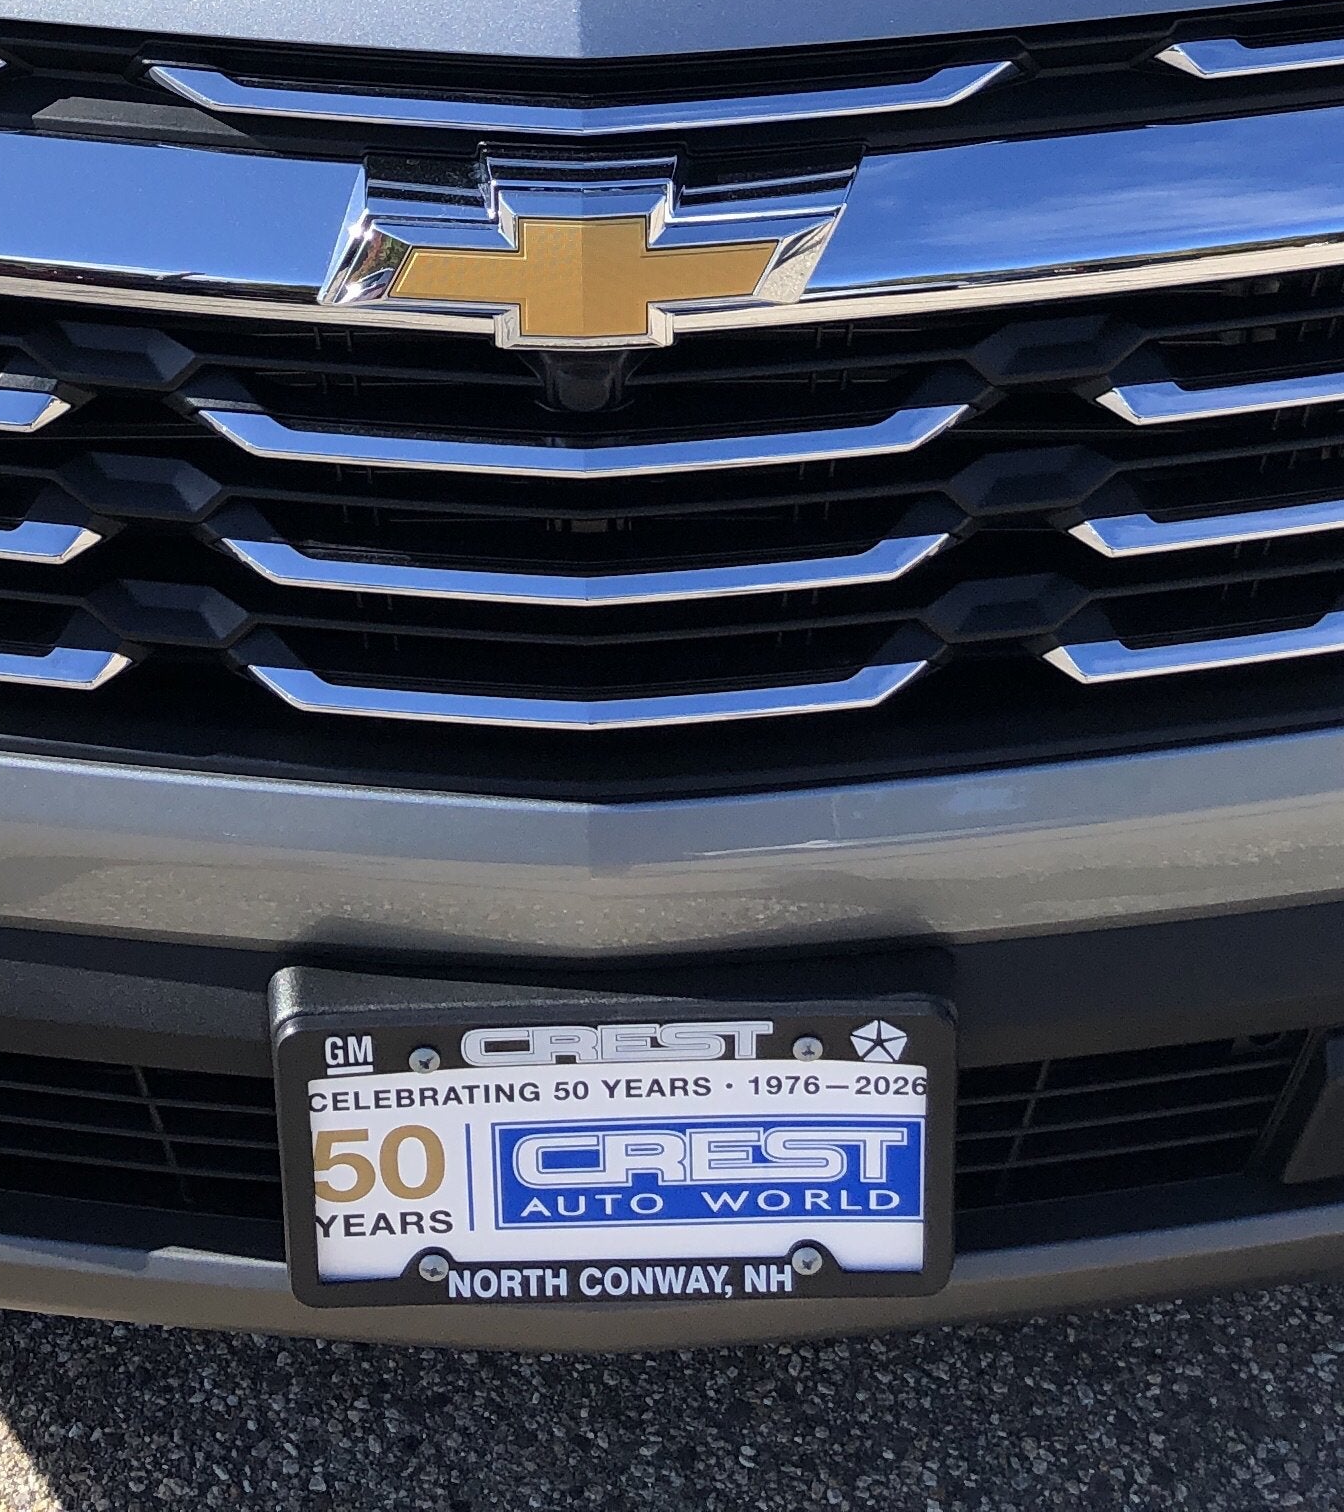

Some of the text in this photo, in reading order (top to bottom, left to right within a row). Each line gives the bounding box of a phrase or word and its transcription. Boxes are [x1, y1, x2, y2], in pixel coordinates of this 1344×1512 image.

[324, 1035, 374, 1067] GM
[460, 1020, 774, 1067] CREST
[308, 1082, 541, 1113] CELEBRATING
[553, 1080, 590, 1101] 50
[601, 1076, 713, 1099] YEARS
[313, 1124, 446, 1203] 50
[512, 1126, 908, 1190] CREST
[520, 1188, 901, 1217] AUTO WORLD
[315, 1209, 454, 1239] YEARS
[448, 1263, 793, 1299] NORTH CONWAY, NH
